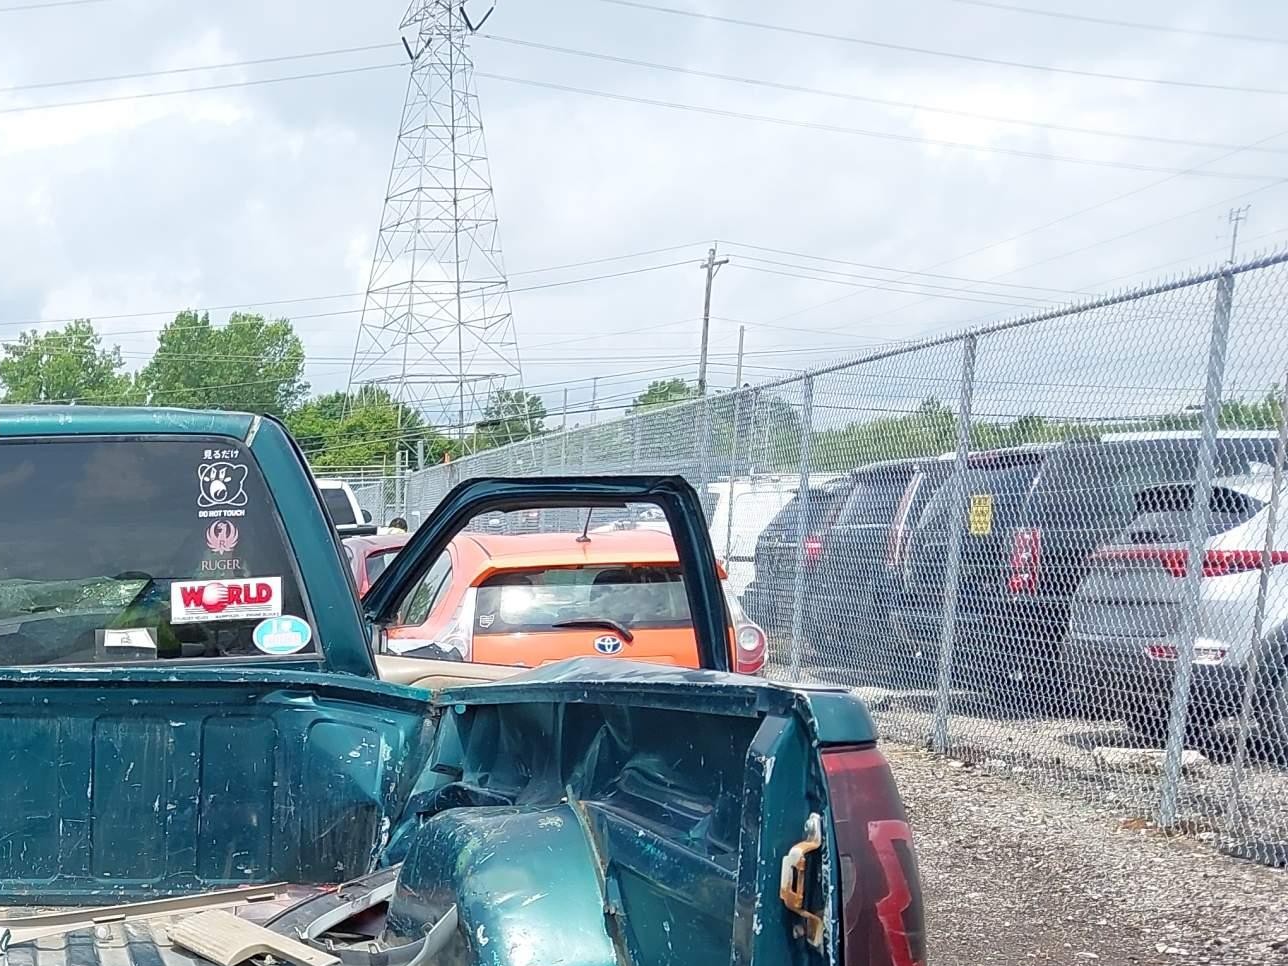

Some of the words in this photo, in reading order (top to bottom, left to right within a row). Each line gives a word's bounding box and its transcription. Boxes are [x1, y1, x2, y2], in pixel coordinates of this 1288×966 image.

[203, 449, 240, 460] 見るだけ
[223, 509, 246, 517] TOUCH
[201, 558, 241, 571] RUGER
[180, 583, 273, 613] WORLD
